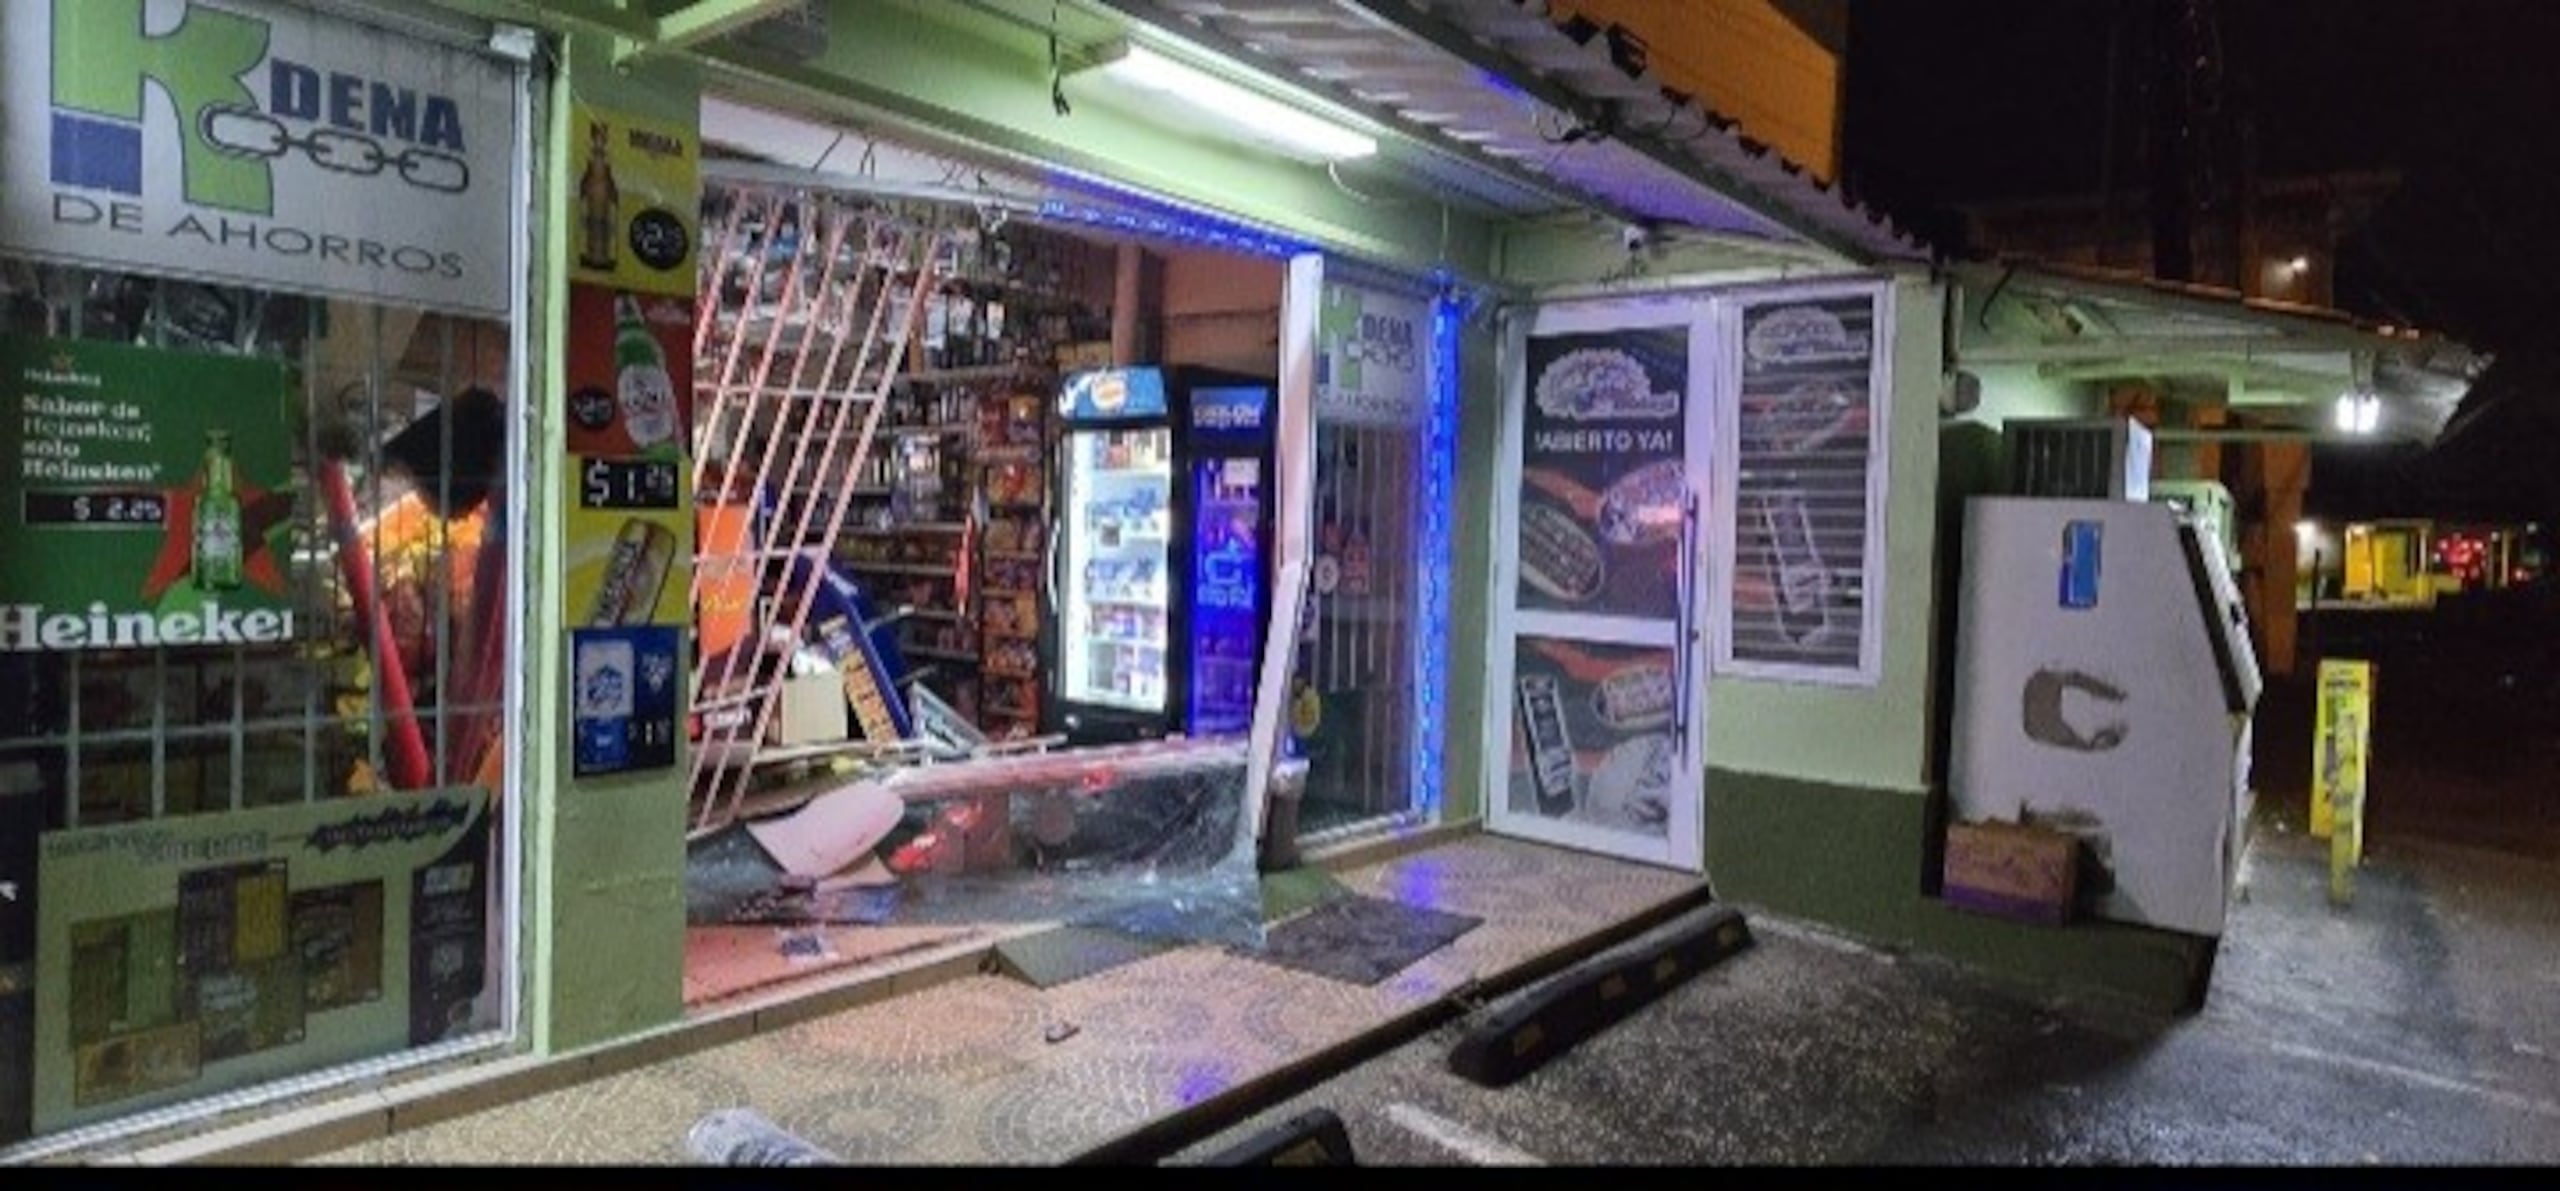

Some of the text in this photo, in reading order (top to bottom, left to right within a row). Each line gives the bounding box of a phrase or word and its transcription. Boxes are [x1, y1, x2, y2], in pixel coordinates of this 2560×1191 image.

[52, 193, 464, 280] DE AHORROS
[1637, 430, 1674, 451] YA!
